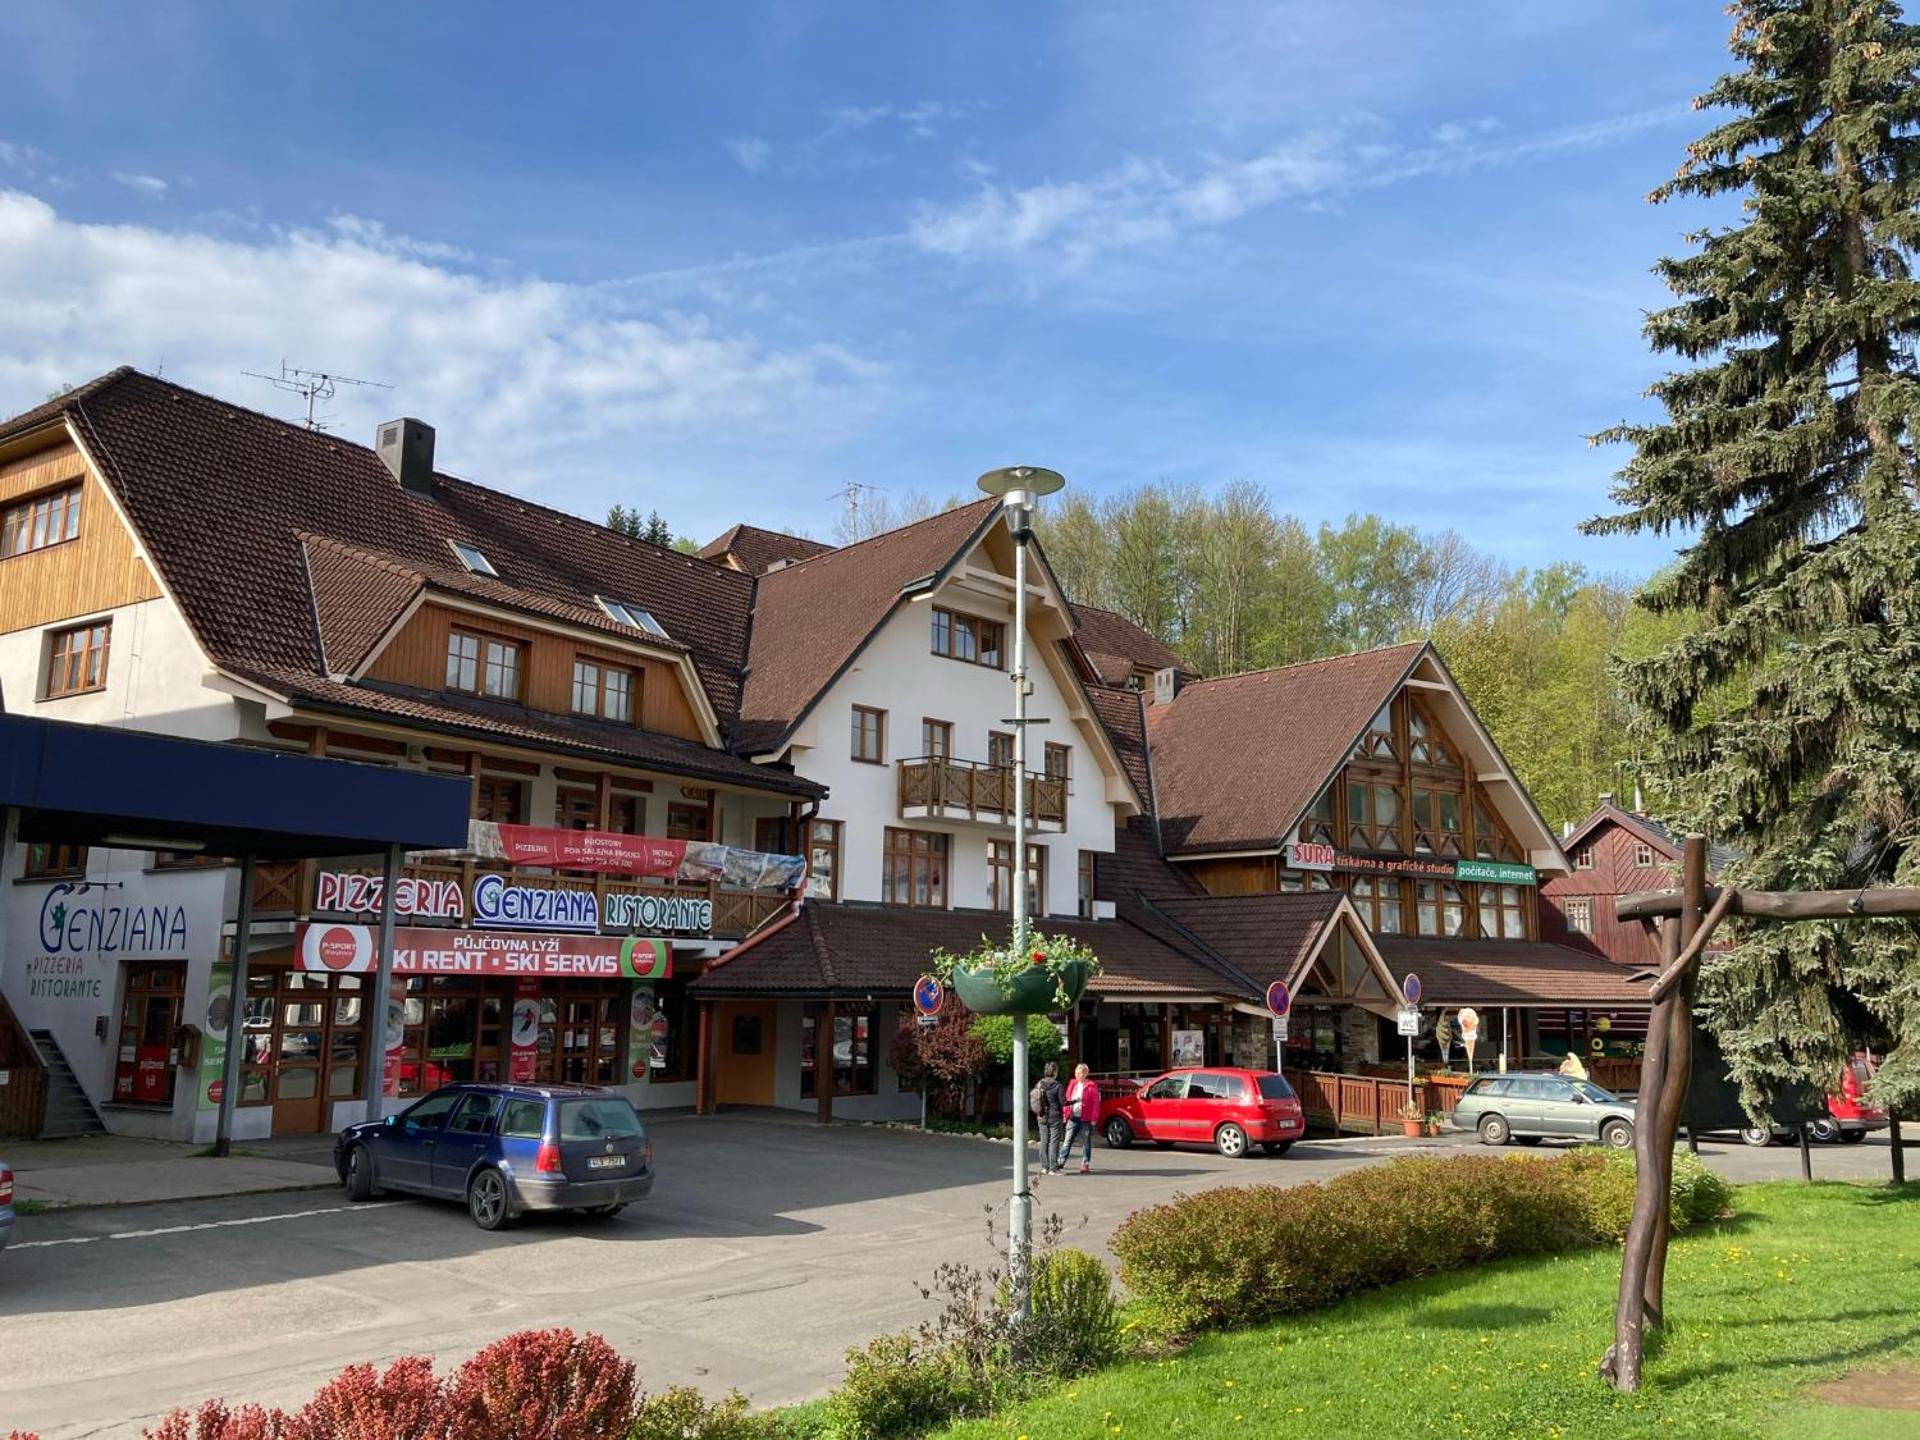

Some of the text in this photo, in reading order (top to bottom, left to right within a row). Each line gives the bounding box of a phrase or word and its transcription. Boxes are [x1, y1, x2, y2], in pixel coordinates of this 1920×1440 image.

[1426, 861, 1456, 875] studio
[1499, 868, 1534, 881] internet
[317, 871, 463, 918] PIZZERIA
[474, 873, 599, 923] GENZIANA
[39, 883, 187, 953] GENZIANA
[605, 893, 712, 931] RISTORANTE
[454, 934, 560, 952] PŮJČOVNA LYŽÍ
[33, 957, 83, 975] PIZZERIA
[422, 951, 487, 971] RENT
[505, 953, 539, 972] SKI
[544, 954, 618, 974] SERVIS
[30, 978, 102, 998] RISTORANTE
[1402, 1020, 1414, 1029] WC
